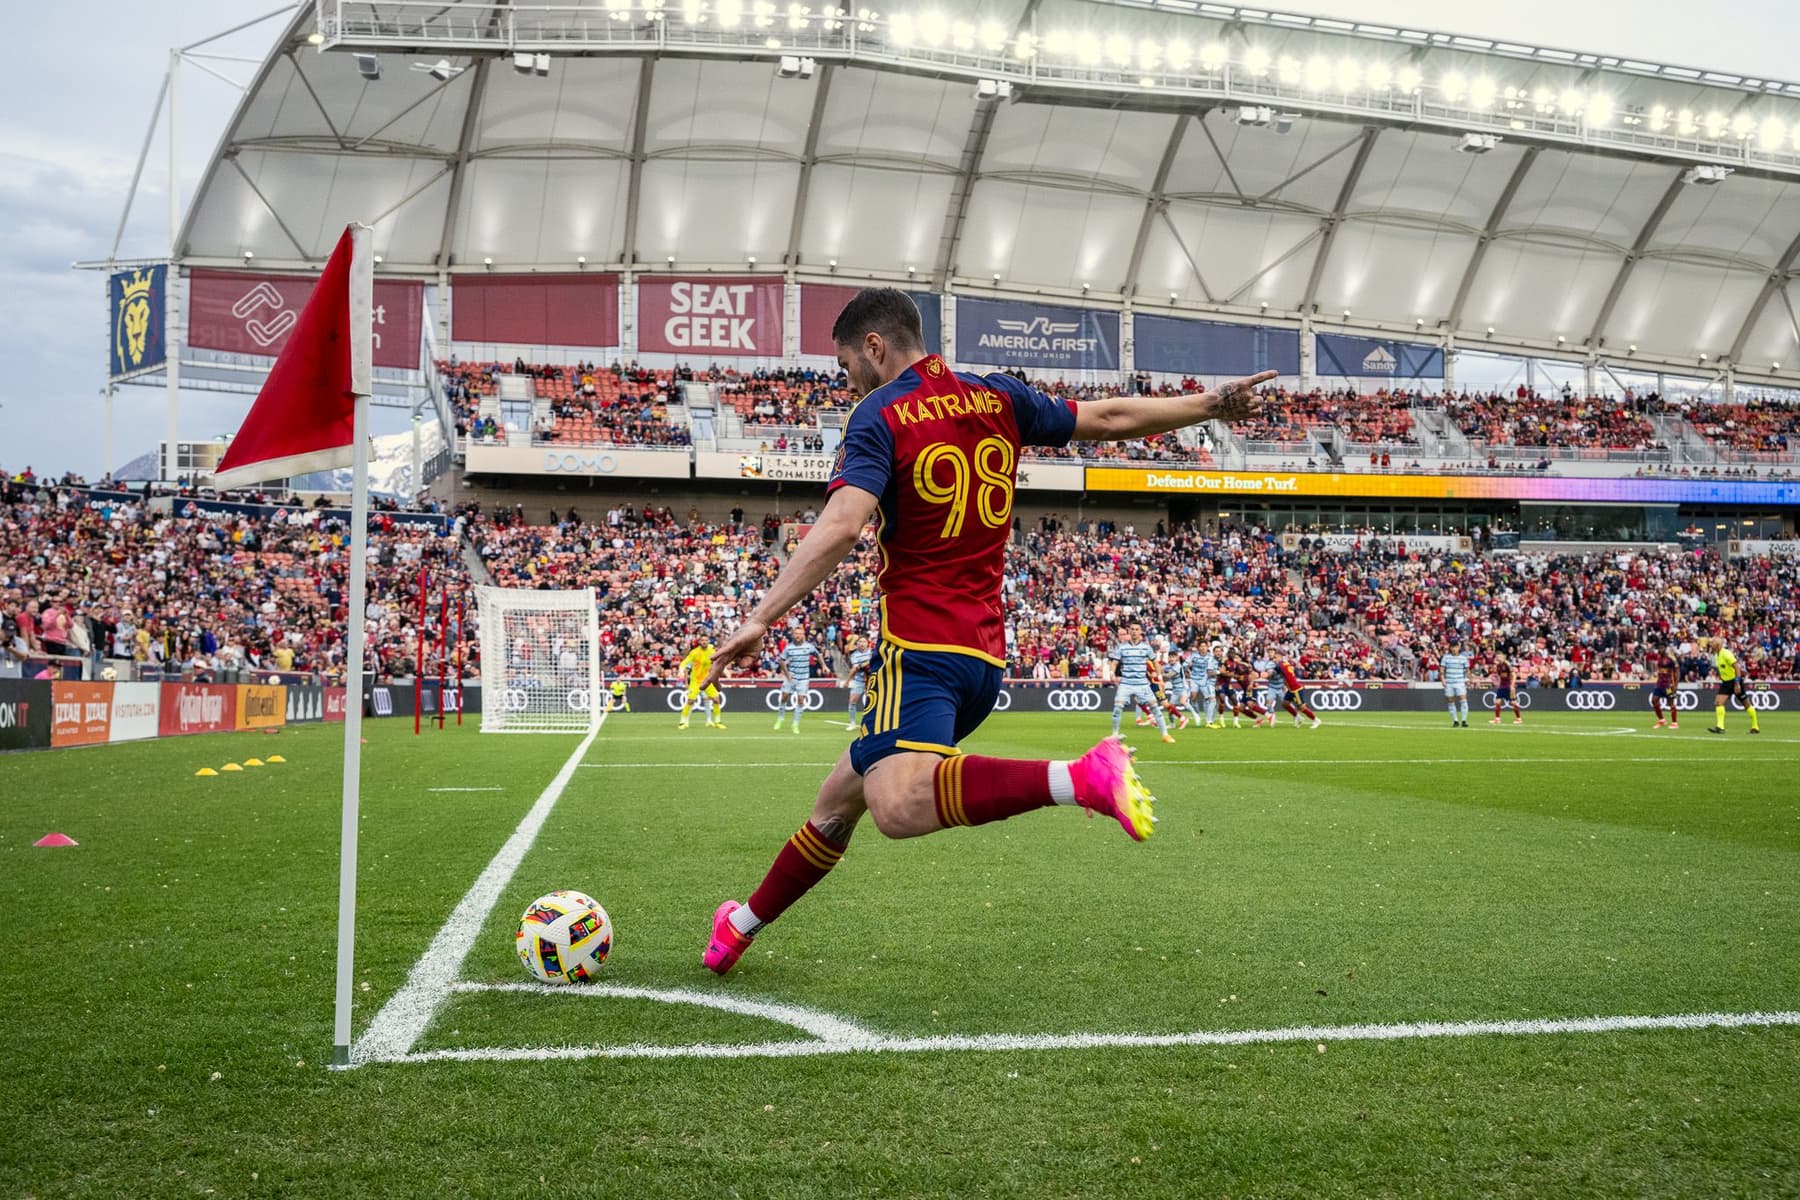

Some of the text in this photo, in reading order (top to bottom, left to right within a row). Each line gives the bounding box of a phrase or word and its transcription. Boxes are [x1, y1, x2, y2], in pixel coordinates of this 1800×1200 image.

[670, 282, 754, 315] SEAT
[665, 317, 757, 350] GEEK
[979, 333, 1098, 352] AMERICA FIRST
[1006, 350, 1038, 358] CREDIT
[543, 451, 617, 473] DOMO
[913, 434, 1014, 538] 98
[1147, 474, 1298, 491] Defend Our Home Turf.
[55, 703, 108, 725] UTAH UTAH
